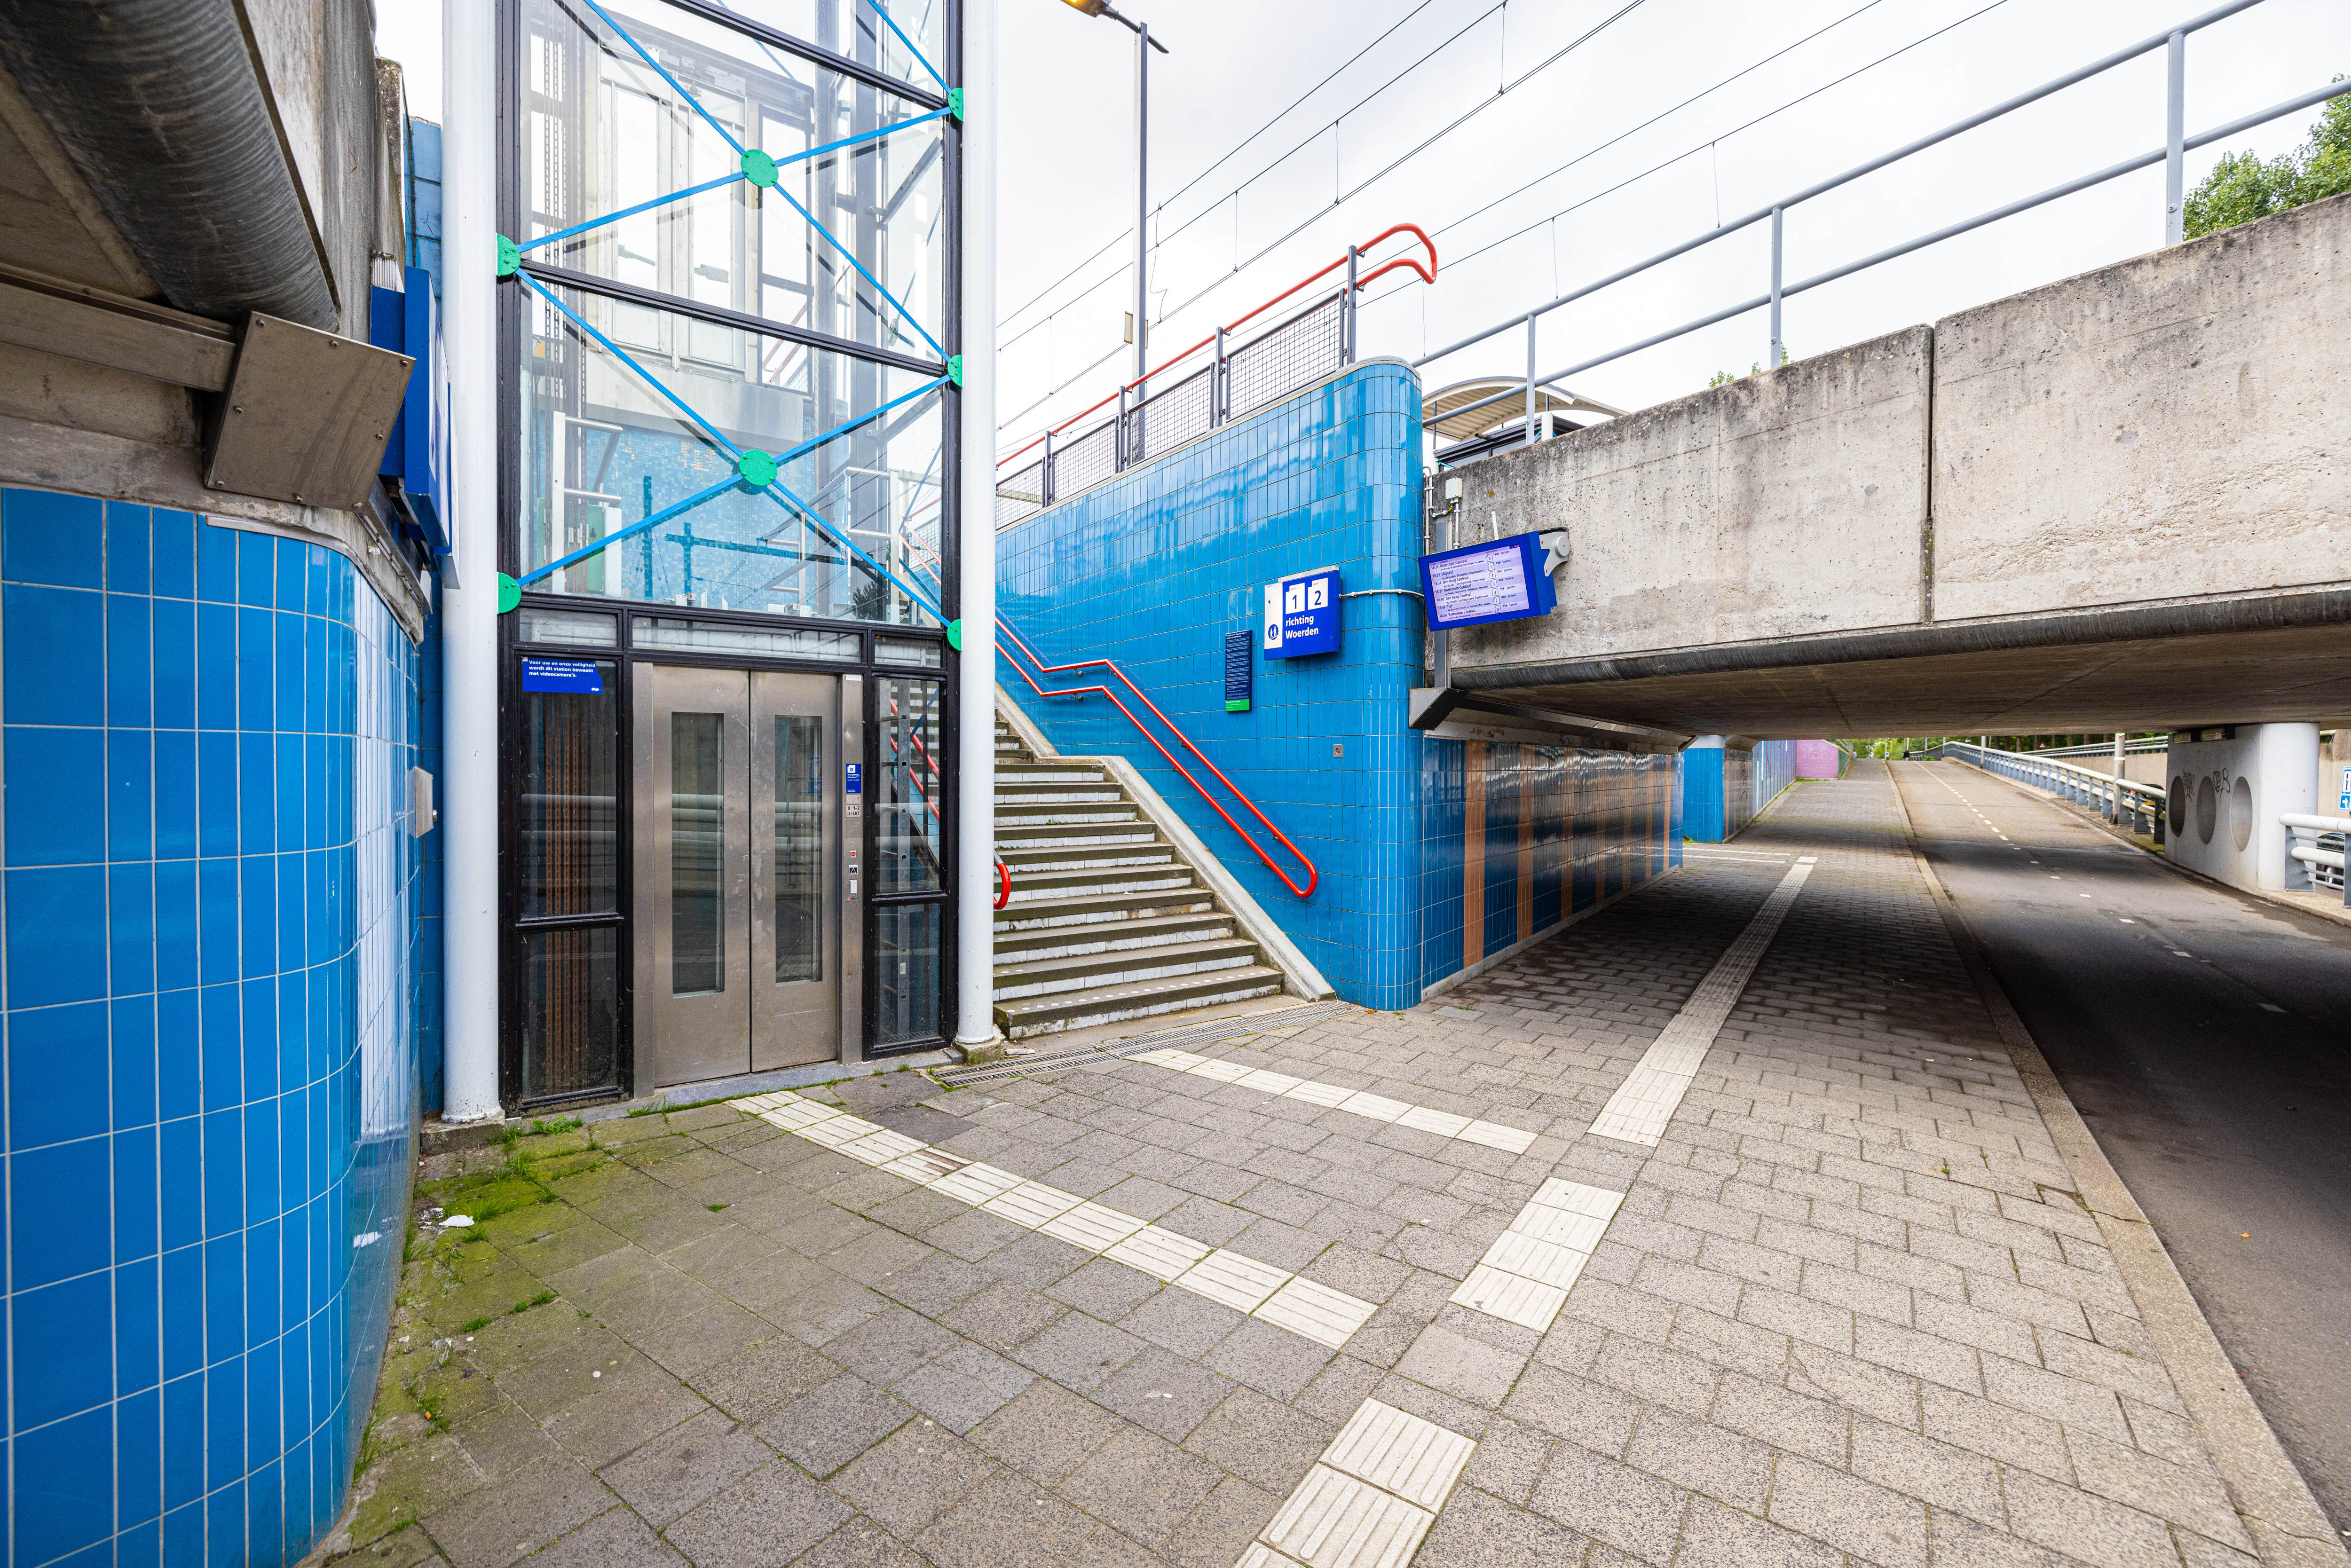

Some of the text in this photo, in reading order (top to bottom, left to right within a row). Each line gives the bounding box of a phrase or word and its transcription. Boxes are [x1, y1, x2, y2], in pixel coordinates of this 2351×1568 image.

[1293, 590, 1321, 609] 1 2
[1286, 615, 1314, 627] richting
[1286, 627, 1319, 639] Woerden
